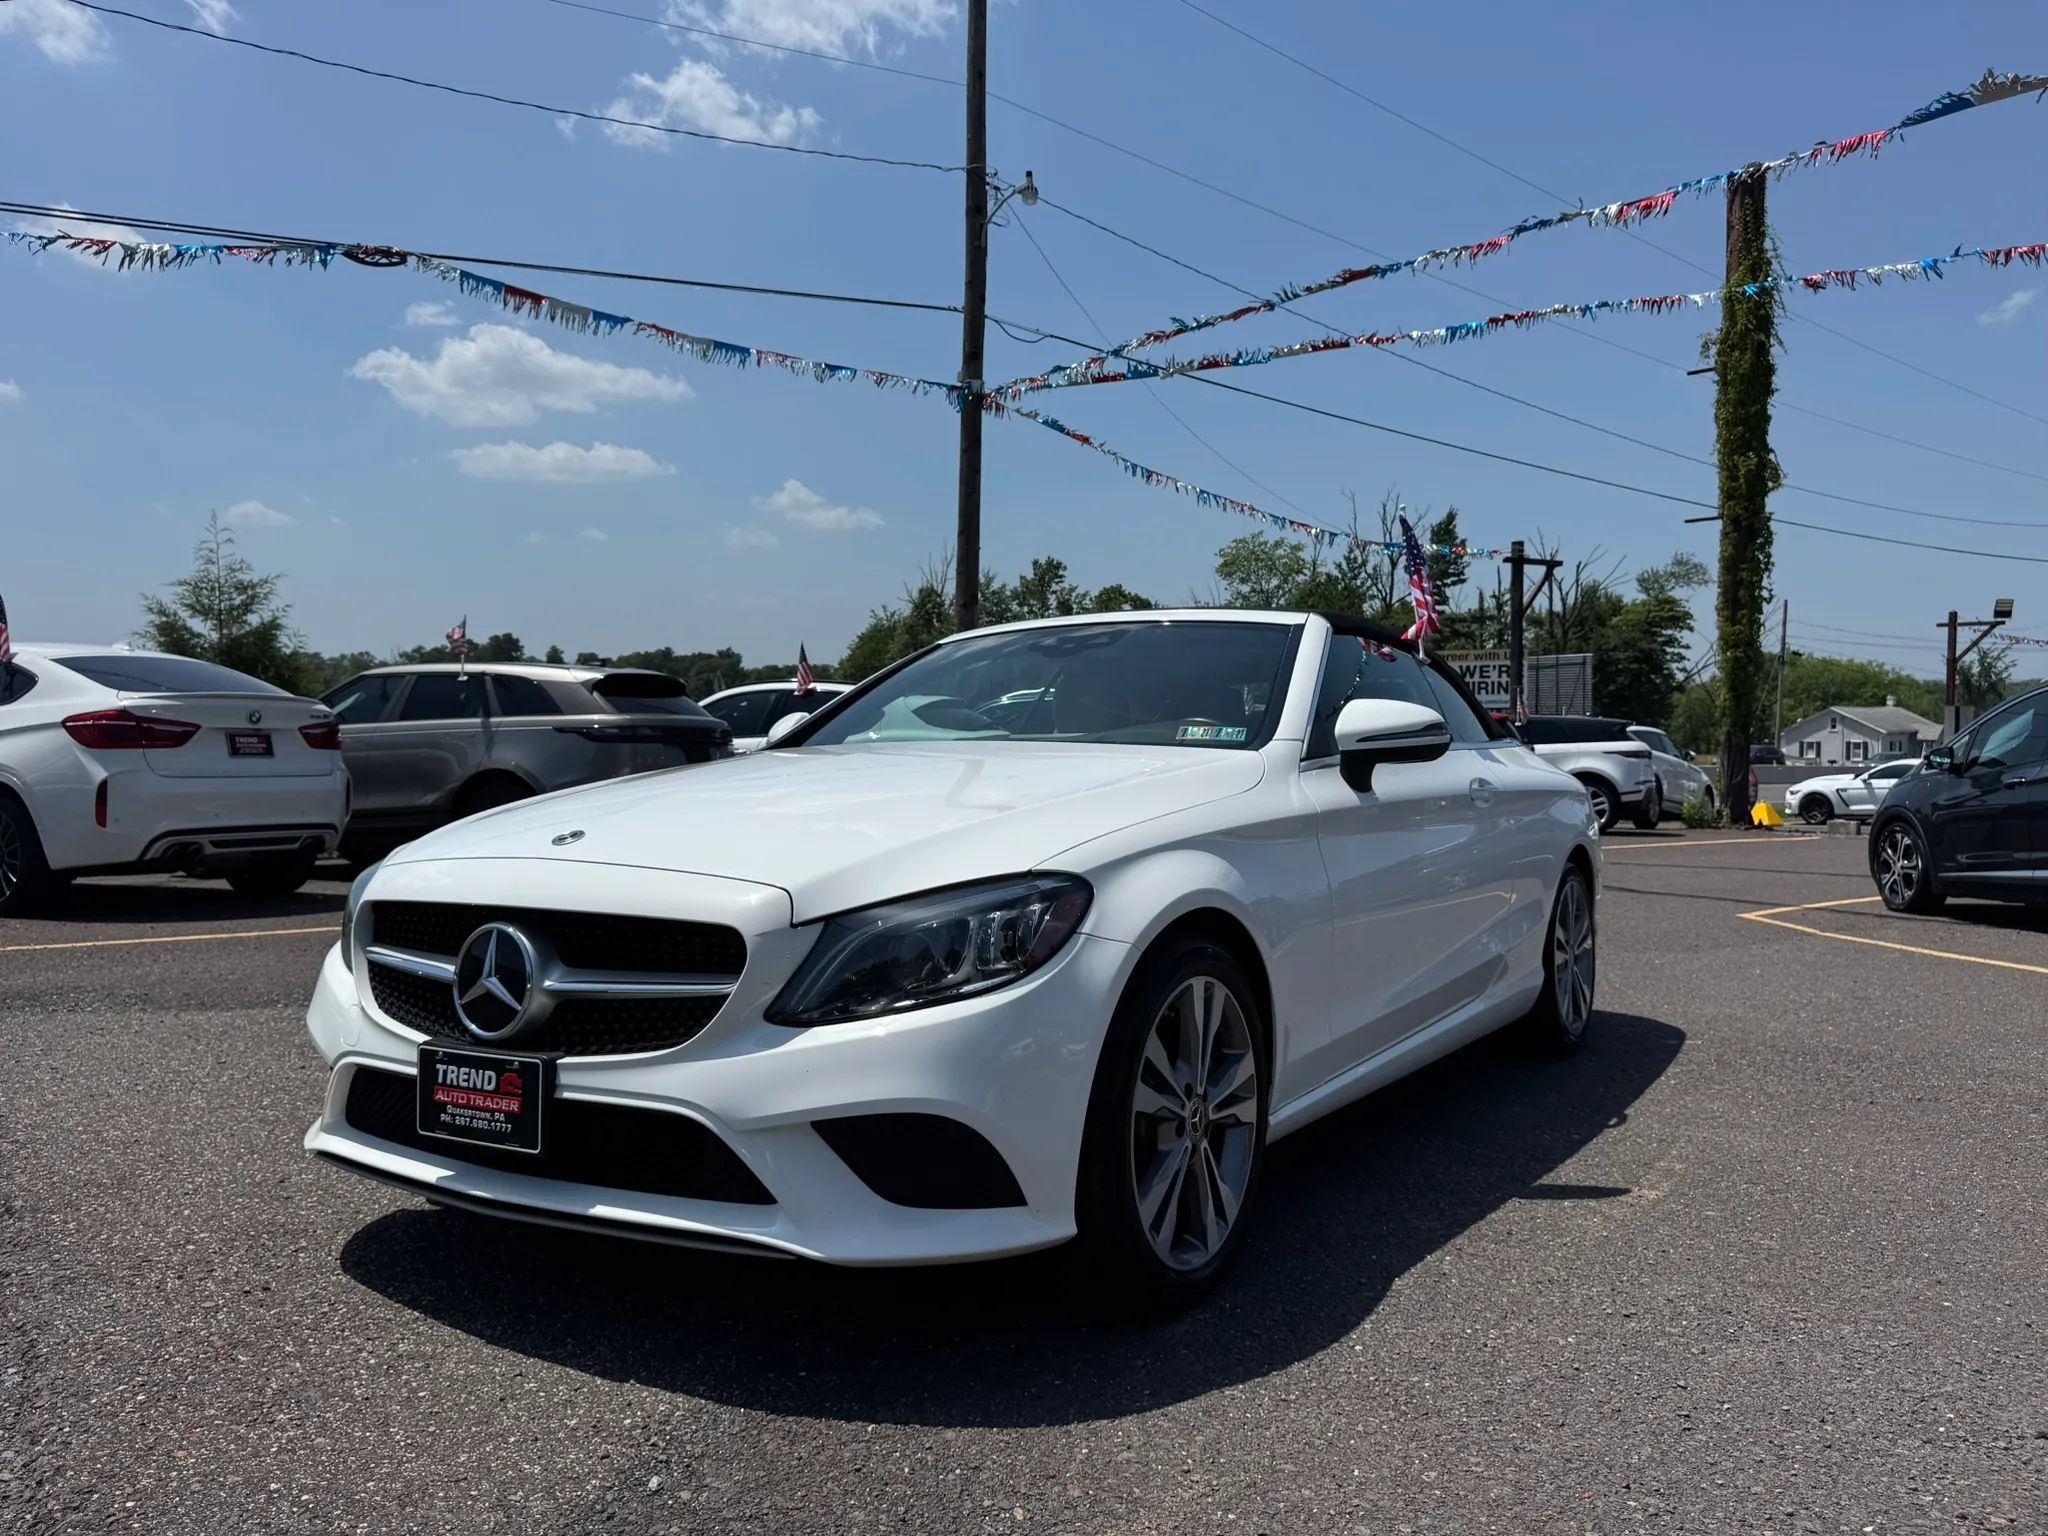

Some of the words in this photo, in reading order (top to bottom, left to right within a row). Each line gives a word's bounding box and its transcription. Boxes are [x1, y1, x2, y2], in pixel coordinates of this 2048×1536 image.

[1473, 650, 1500, 661] with
[1458, 664, 1511, 679] WE'R
[1466, 680, 1510, 695] IRIN
[436, 1064, 496, 1091] TREND
[440, 1113, 454, 1124] PH:
[494, 1112, 506, 1122] PA
